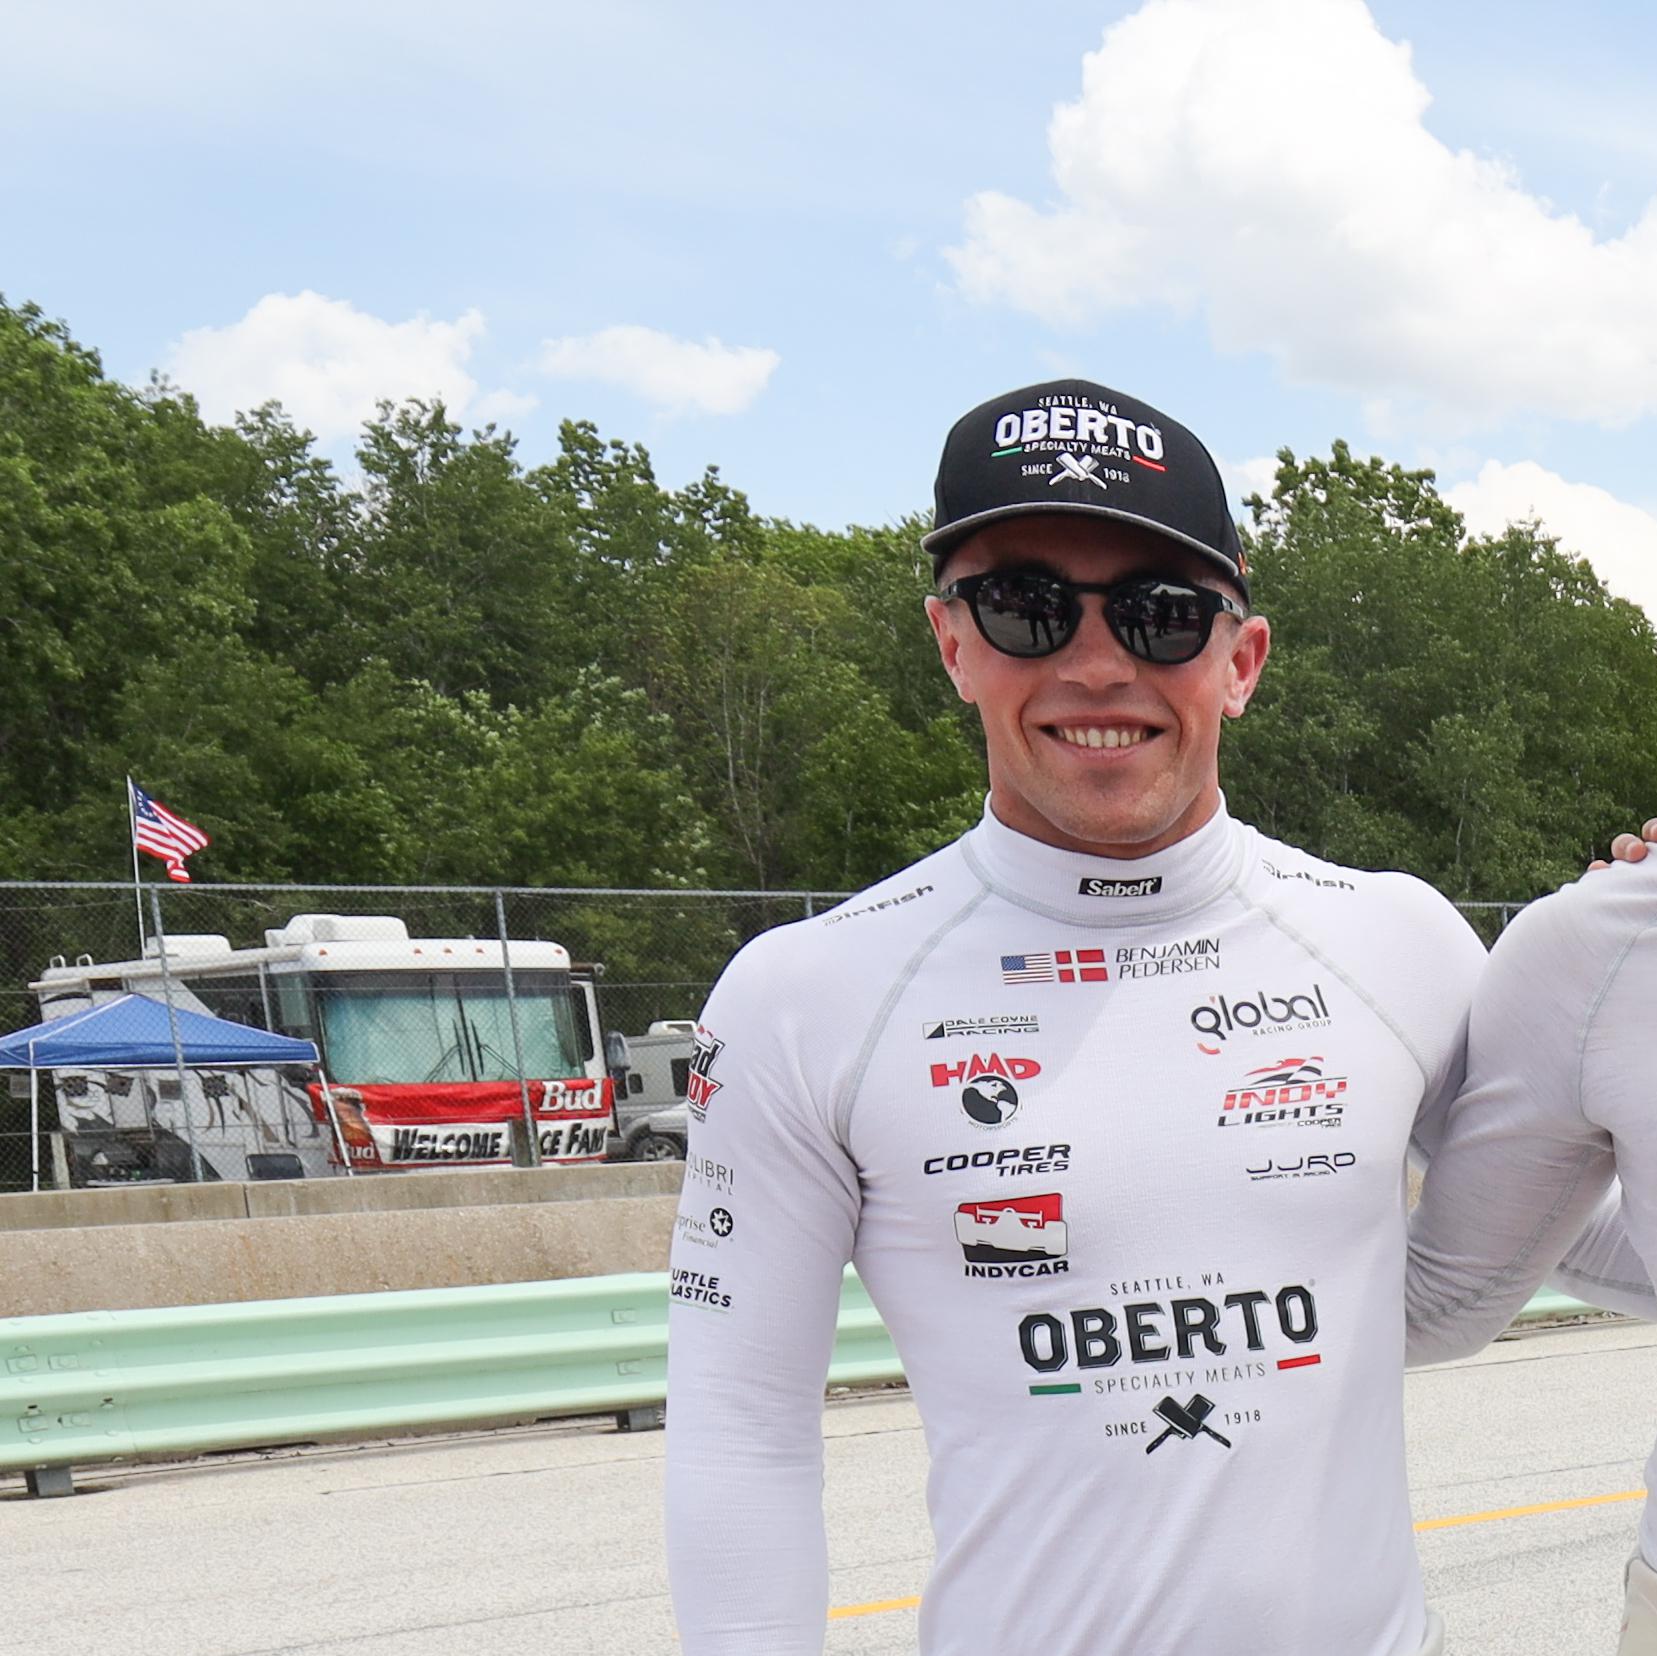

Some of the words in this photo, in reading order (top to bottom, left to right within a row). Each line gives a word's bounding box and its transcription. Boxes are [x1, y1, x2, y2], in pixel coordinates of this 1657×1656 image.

[1099, 400, 1118, 415] WA
[994, 406, 1164, 460] OBERTO
[1021, 463, 1053, 476] SINCE
[1086, 878, 1158, 896] Sabelt
[1116, 938, 1220, 963] BENJAMIN
[1119, 955, 1220, 980] PEDERSEN
[945, 1018, 986, 1027] DALE
[990, 1015, 1038, 1024] COYNE
[1190, 983, 1329, 1040] global
[947, 1026, 1040, 1037] RACING
[1252, 1023, 1293, 1036] RACING
[1298, 1019, 1332, 1031] GROUP
[930, 1052, 1041, 1088] HMD
[539, 1080, 603, 1112] Bud
[1223, 1081, 1347, 1111] INDY
[1217, 1103, 1344, 1127] LIGHTS
[393, 1127, 503, 1161] WELCOME
[924, 1143, 1071, 1175] COOPER
[995, 1160, 1069, 1177] TIRES
[1246, 1152, 1356, 1174] JJRD
[964, 1259, 1069, 1279] INDYCAR
[1109, 1276, 1192, 1296] SEATTLE,
[1202, 1271, 1225, 1286] WA
[1018, 1285, 1319, 1374] OBERTO
[1094, 1370, 1196, 1394] SPECIALTY
[1206, 1362, 1267, 1384] MEATS
[1105, 1421, 1148, 1437] SINCE
[1224, 1409, 1262, 1426] 1918
